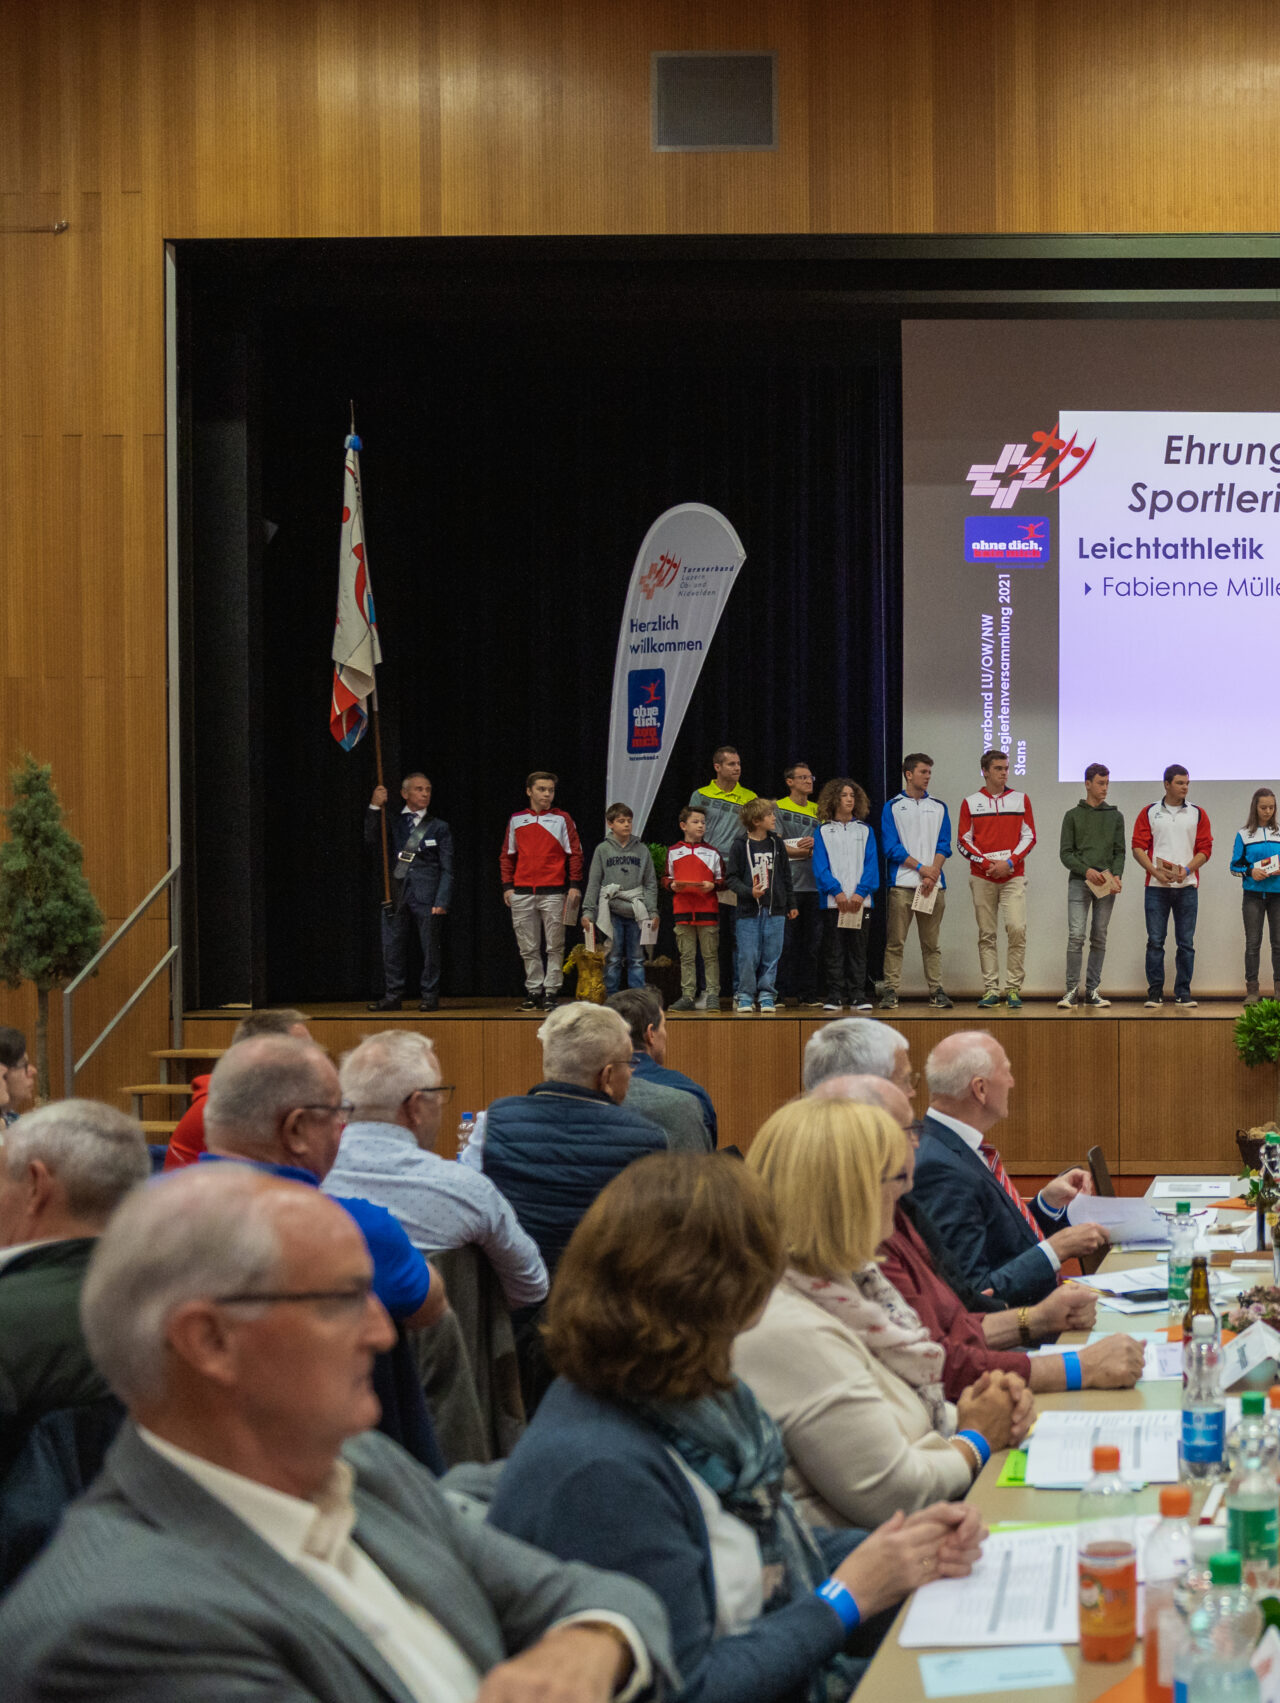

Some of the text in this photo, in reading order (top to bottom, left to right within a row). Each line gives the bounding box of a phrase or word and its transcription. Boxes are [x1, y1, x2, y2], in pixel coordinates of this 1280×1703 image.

[972, 540, 1043, 551] ohne dich,
[1078, 536, 1265, 560] Leichtathletik
[683, 565, 735, 573] Turnverband
[1103, 576, 1218, 597] Fabienne
[630, 614, 679, 634] Herzlich
[629, 637, 703, 655] willkommen
[998, 574, 1012, 756] egiertenversammlung 2021
[981, 614, 995, 768] verband LU/OW/NW
[633, 704, 659, 717] ohne
[1014, 740, 1027, 776] Stans
